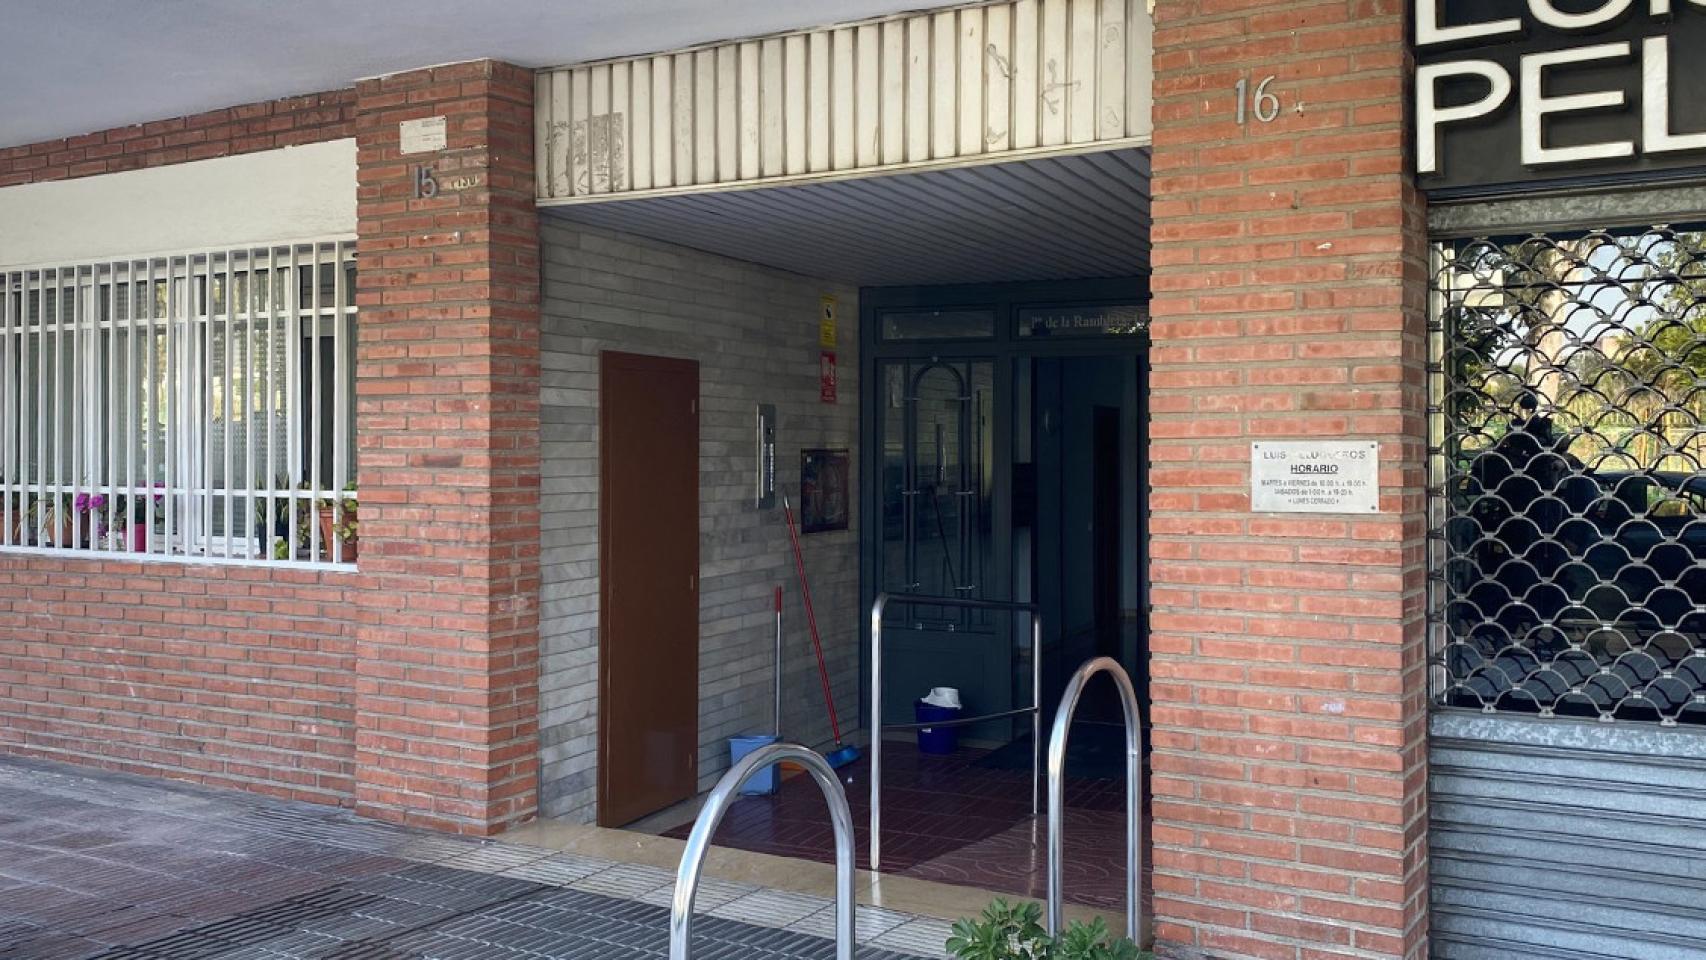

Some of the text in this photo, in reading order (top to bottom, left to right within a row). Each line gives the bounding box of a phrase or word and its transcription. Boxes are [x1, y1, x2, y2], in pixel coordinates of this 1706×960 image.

[1236, 75, 1279, 124] 16
[414, 165, 439, 198] 15
[1263, 450, 1286, 460] LUIS
[1290, 464, 1339, 474] HORARIO
